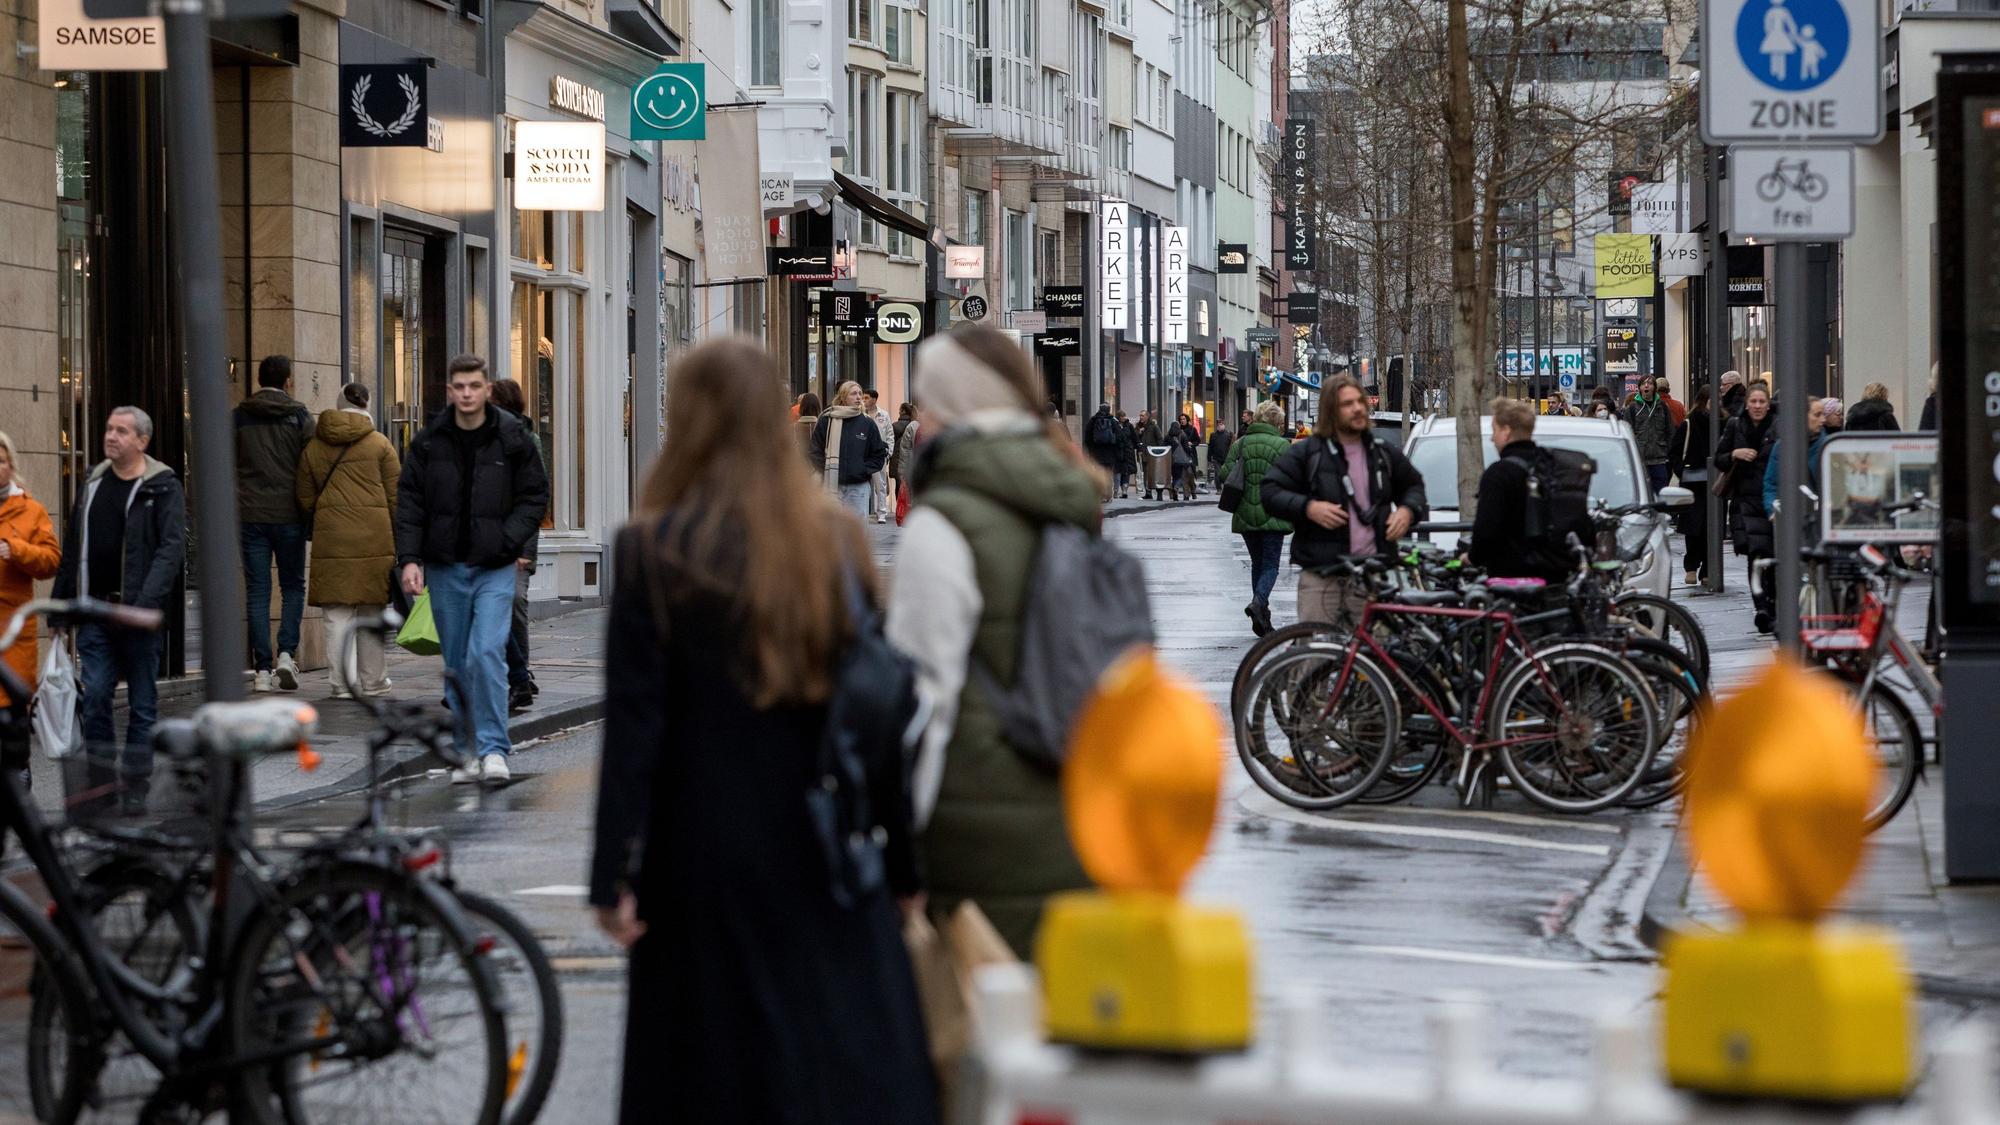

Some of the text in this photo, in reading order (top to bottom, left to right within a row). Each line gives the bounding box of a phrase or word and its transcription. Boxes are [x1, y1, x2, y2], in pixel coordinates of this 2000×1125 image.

[56, 27, 156, 45] SAMSØE
[556, 75, 582, 113] SCOTCH
[587, 87, 605, 121] SODA
[1750, 100, 1838, 129] ZONE
[1295, 124, 1306, 160] SON
[527, 148, 590, 160] SCOTCH
[530, 163, 590, 174] & SODA
[1295, 166, 1305, 177] &
[1773, 206, 1813, 228] frei
[778, 257, 827, 265] MAC
[1608, 248, 1647, 264] little
[1668, 249, 1698, 260] YPS
[1107, 206, 1123, 326] ARKET
[1602, 264, 1654, 275] FOODIE
[1168, 230, 1183, 340] ARKET
[878, 317, 918, 328] ONLY
